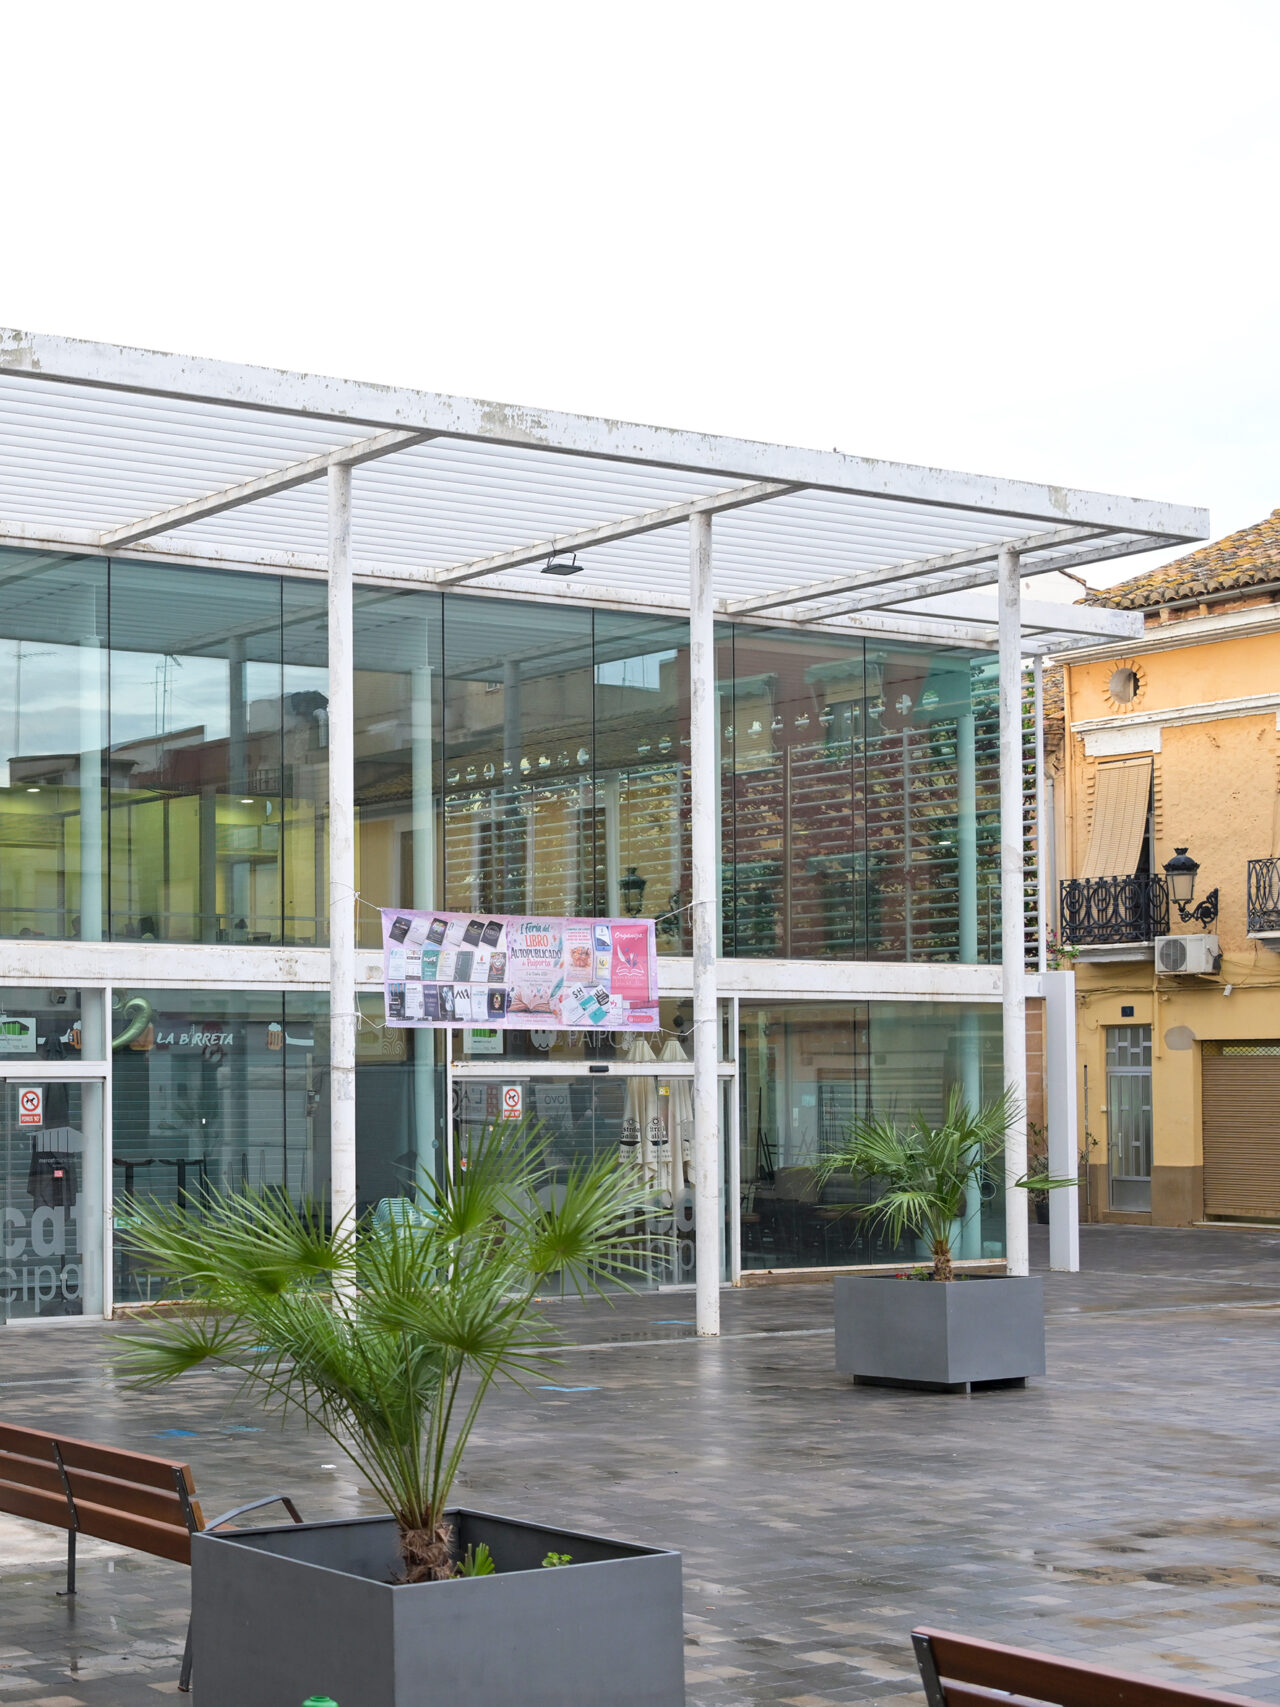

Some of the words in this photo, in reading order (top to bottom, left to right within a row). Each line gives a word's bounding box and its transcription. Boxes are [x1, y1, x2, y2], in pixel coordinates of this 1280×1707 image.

[525, 922, 541, 933] Feria
[525, 935, 549, 947] LIBRO
[156, 1032, 174, 1044] LA
